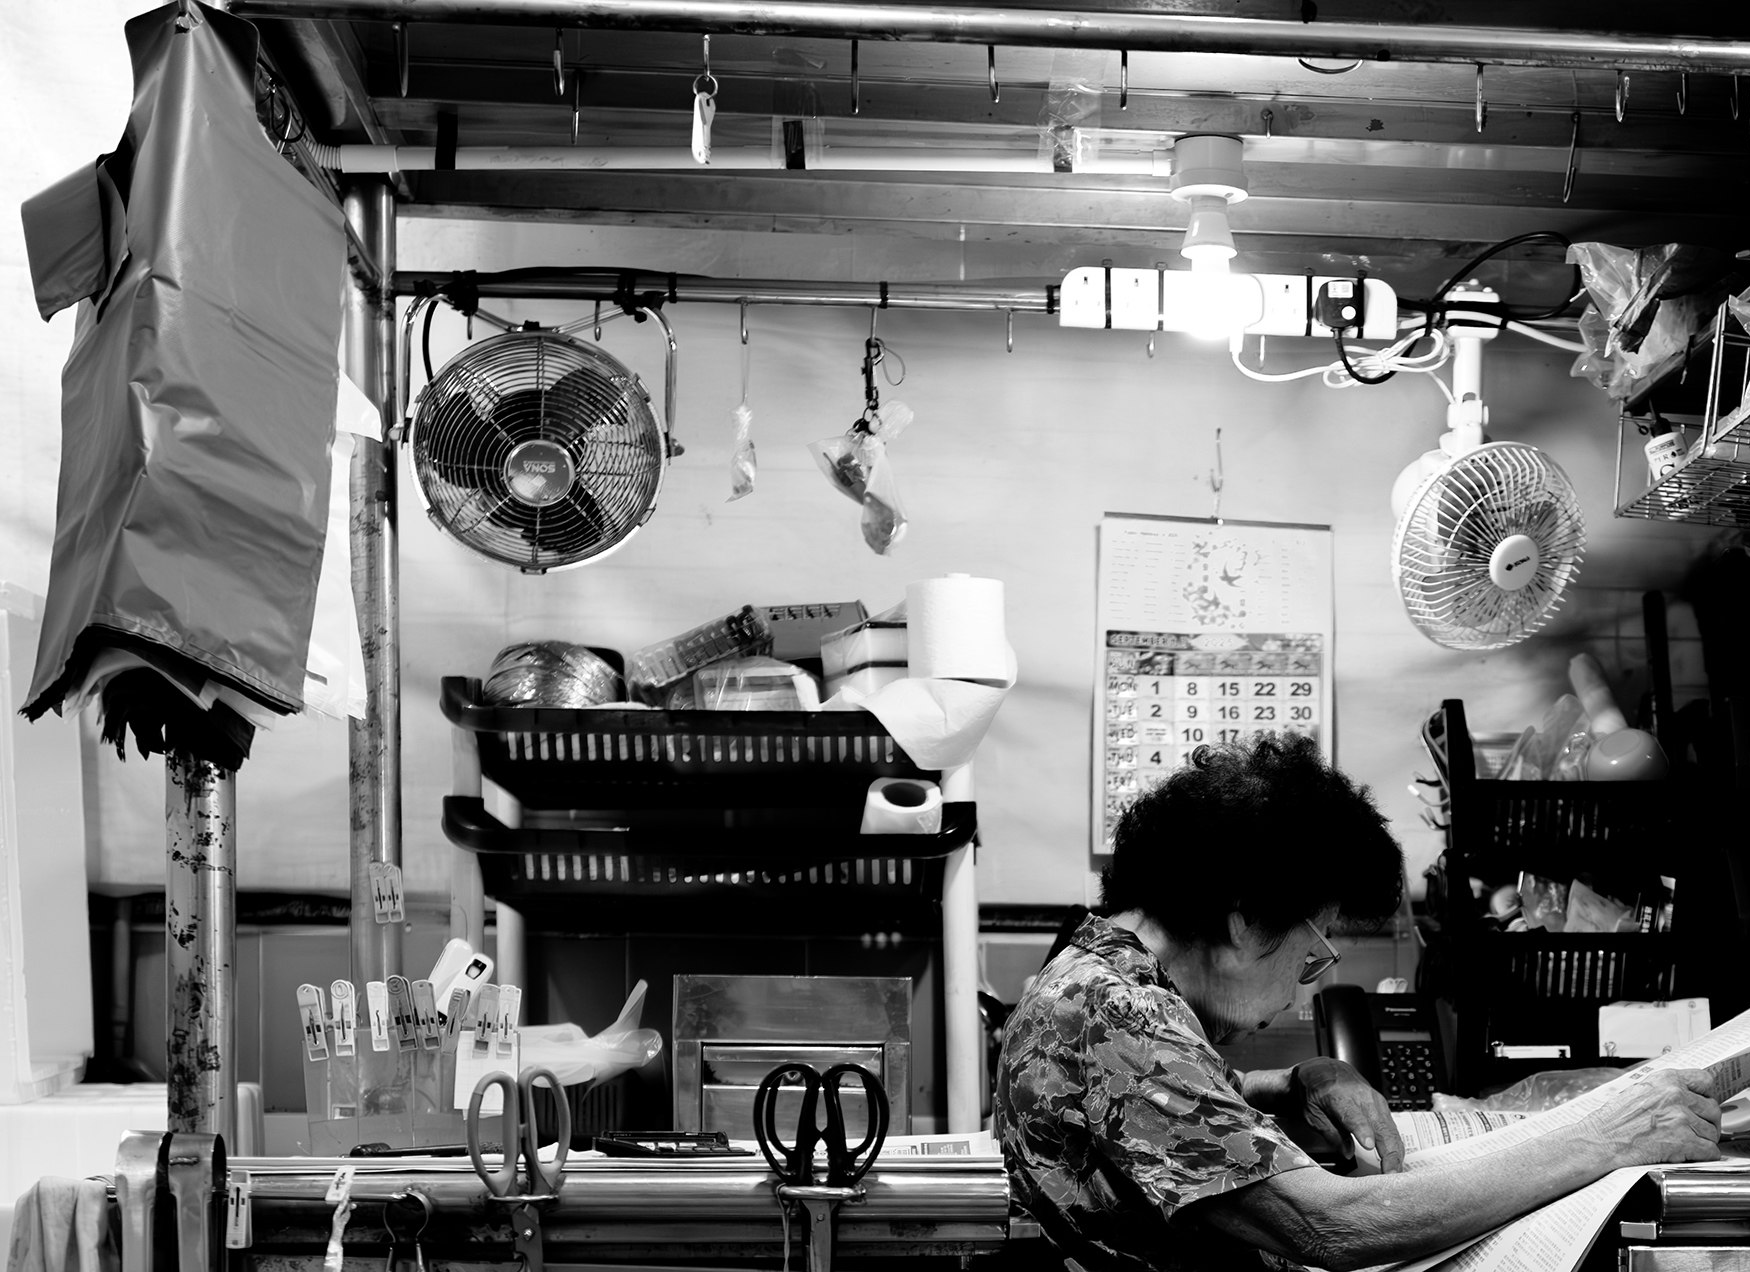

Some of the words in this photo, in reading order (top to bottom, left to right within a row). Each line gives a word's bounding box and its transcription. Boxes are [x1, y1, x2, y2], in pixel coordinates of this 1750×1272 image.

[523, 461, 556, 473] SONA
[1110, 634, 1169, 644] SEPTEMBER
[1151, 681, 1160, 695] 1
[1187, 682, 1198, 696] 8
[1219, 682, 1240, 696] 15
[1254, 682, 1276, 696] 22
[1290, 682, 1312, 696] 29
[1150, 704, 1162, 718] 2
[1187, 705, 1198, 719] 9
[1219, 706, 1240, 720] 16
[1254, 706, 1276, 720] 23
[1290, 706, 1312, 720] 30
[1183, 728, 1204, 742] 10
[1220, 729, 1239, 743] 17
[1150, 751, 1162, 765] 4
